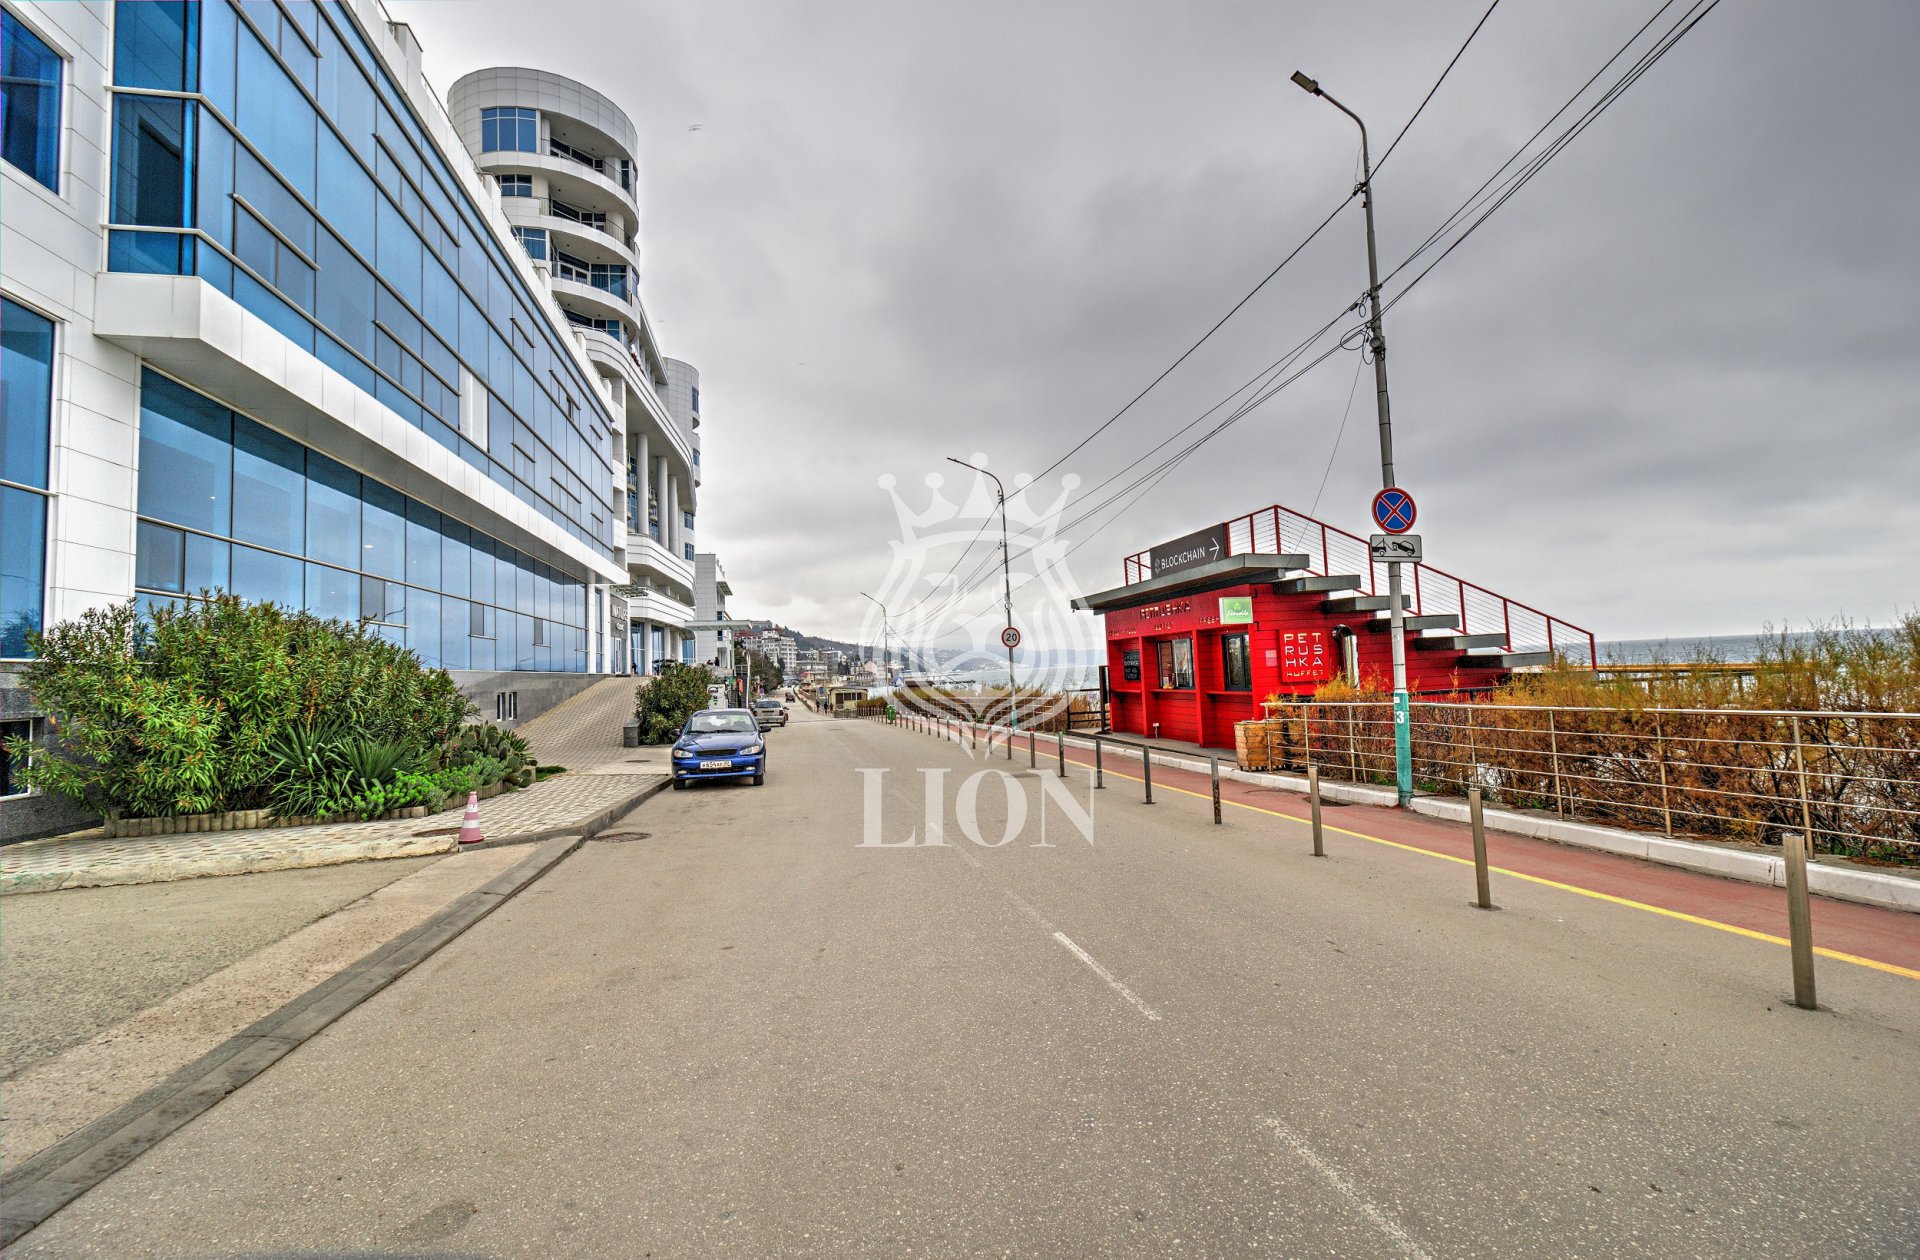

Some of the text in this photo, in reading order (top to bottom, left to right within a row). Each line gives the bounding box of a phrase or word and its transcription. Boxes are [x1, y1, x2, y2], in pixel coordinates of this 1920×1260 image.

[1160, 546, 1206, 570] BLOCKCHAIN
[1006, 633, 1018, 642] 20
[1283, 632, 1321, 643] PET
[1284, 644, 1323, 656] RUS
[1285, 657, 1323, 667] HKA
[1396, 710, 1405, 724] 3
